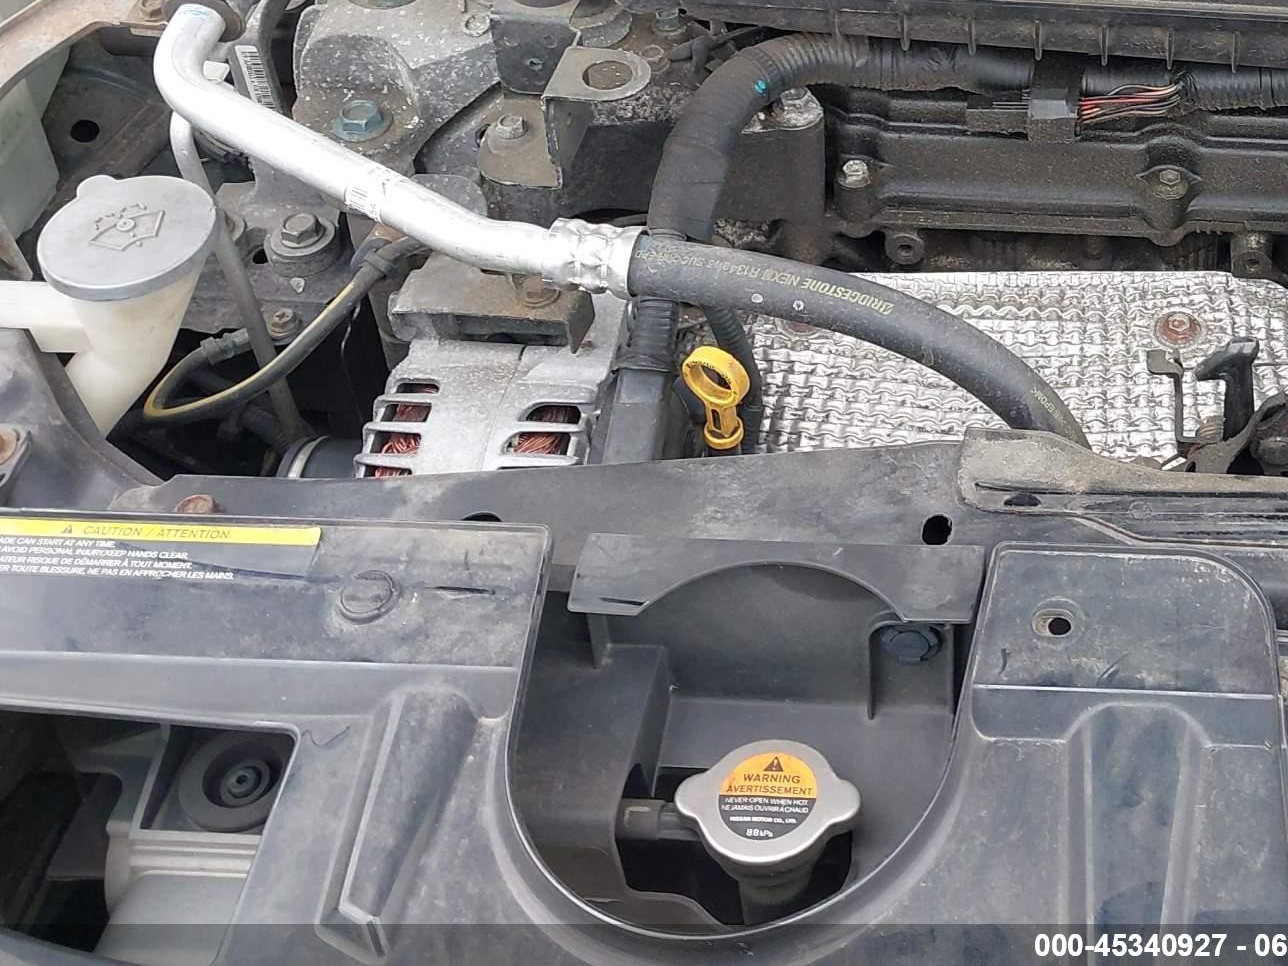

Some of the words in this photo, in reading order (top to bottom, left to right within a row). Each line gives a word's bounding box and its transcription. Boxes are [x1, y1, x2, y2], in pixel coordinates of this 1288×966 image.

[801, 278, 895, 315] BRIDGESTONE
[83, 524, 144, 538] CAUTION
[155, 528, 231, 539] ATTENTION
[17, 537, 36, 546] CAN
[37, 538, 64, 547] START
[64, 539, 76, 547] AT
[76, 540, 96, 548] ANY
[1, 545, 28, 554] AVOID
[29, 546, 74, 555] PERSONAL
[127, 549, 158, 559] HANDS
[26, 556, 60, 565] RISQUE
[60, 557, 74, 566] DE
[131, 560, 152, 569] TOUT
[11, 564, 40, 573] TOUTE
[86, 567, 101, 576] NE
[101, 568, 120, 576] PAS
[119, 569, 135, 577] EN
[187, 571, 206, 579] LES
[743, 773, 801, 784] WARNING
[726, 785, 813, 795] AVERTISSEMENT
